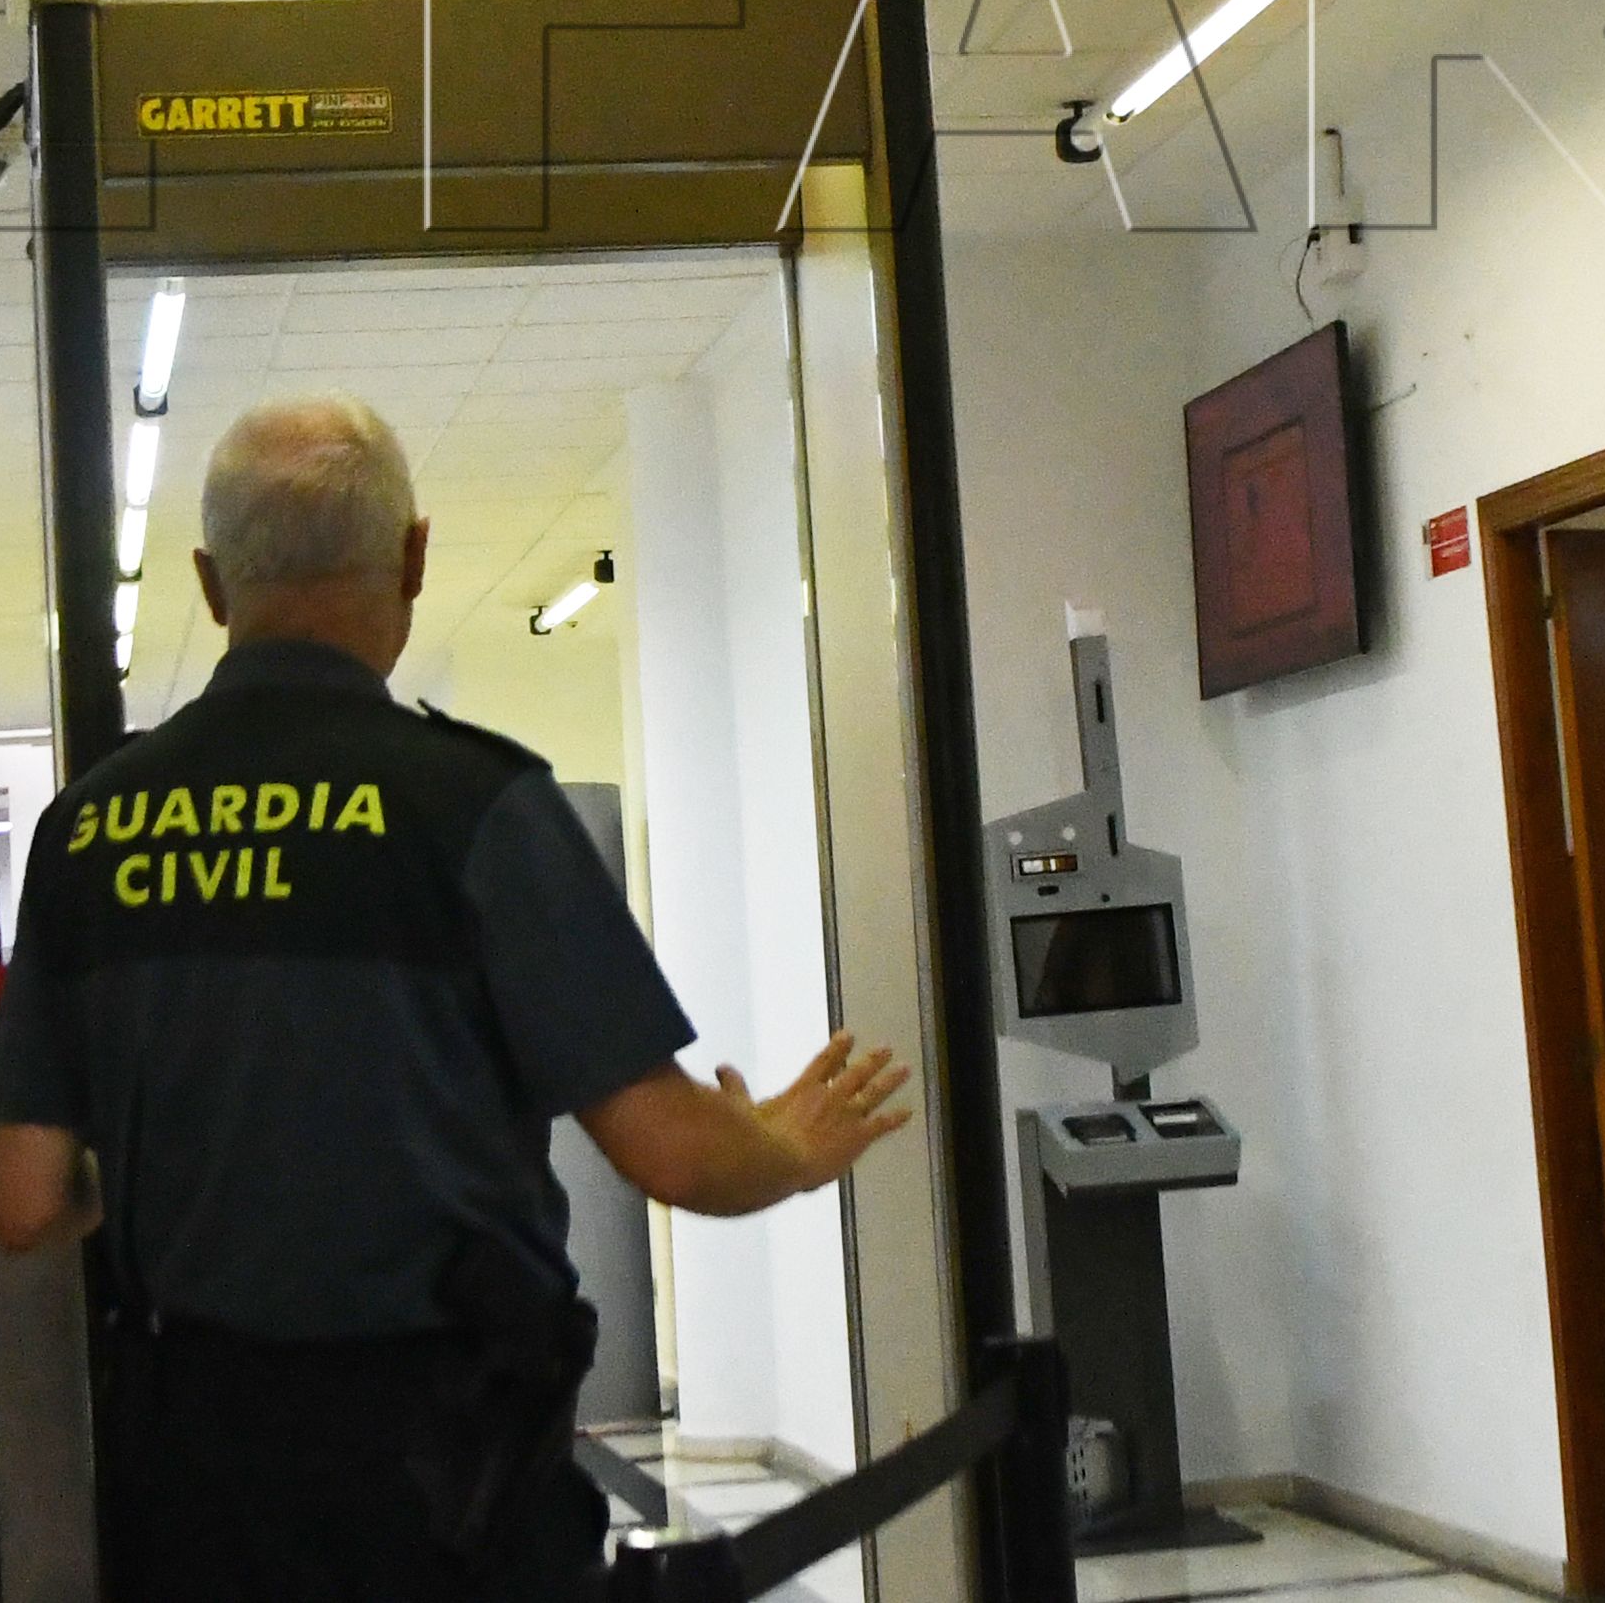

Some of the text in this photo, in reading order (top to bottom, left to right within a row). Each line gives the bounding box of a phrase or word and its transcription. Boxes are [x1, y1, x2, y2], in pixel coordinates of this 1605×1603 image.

[140, 94, 311, 132] GARRETT
[67, 781, 387, 854] GUARDIA
[114, 847, 292, 908] CIVIL
